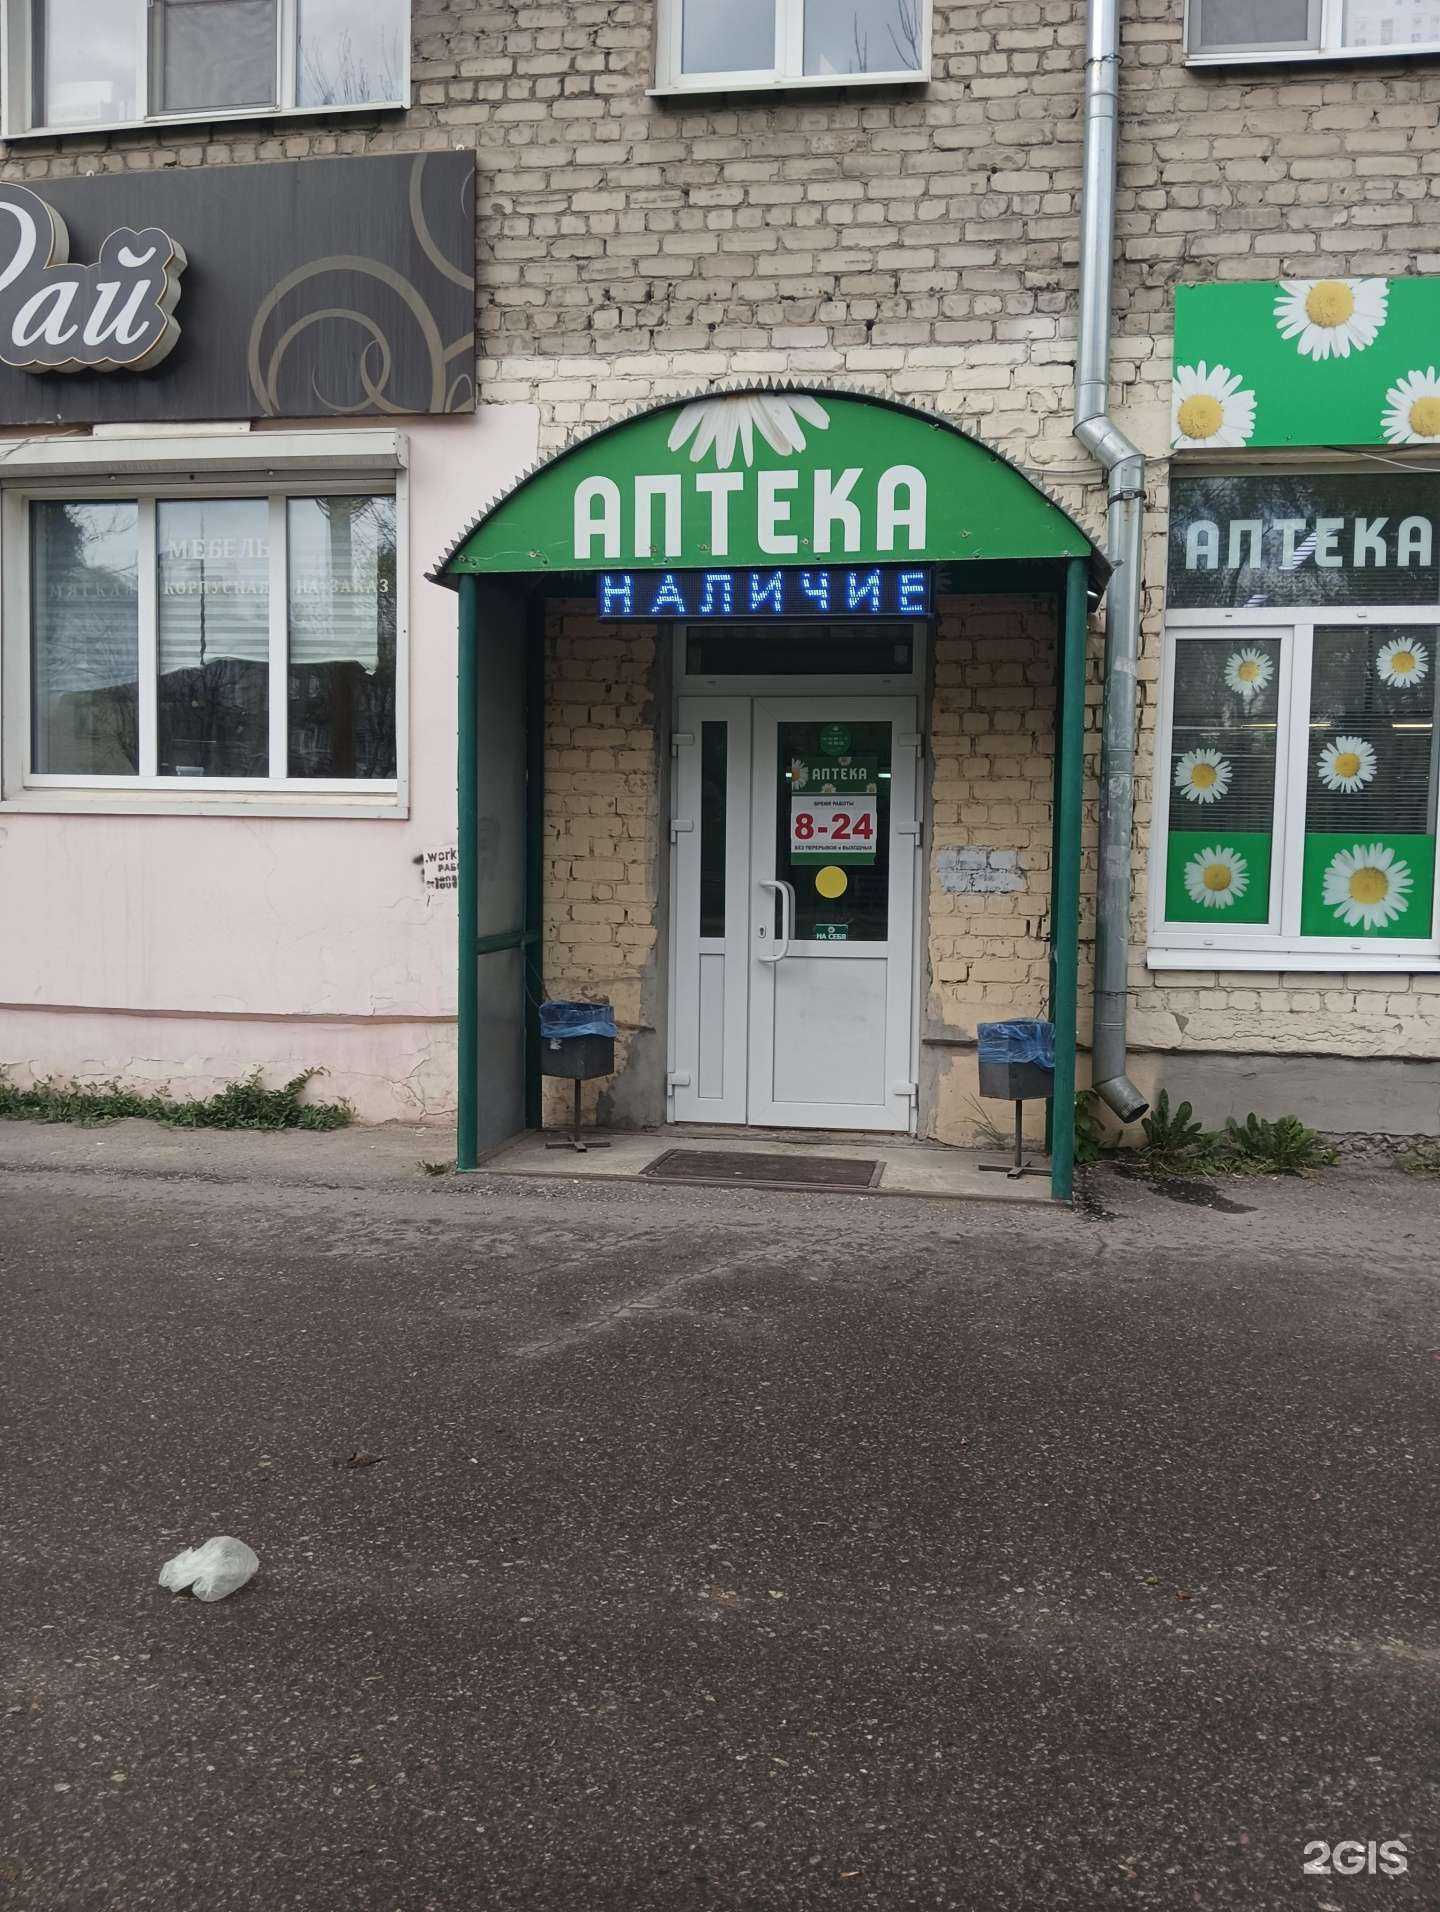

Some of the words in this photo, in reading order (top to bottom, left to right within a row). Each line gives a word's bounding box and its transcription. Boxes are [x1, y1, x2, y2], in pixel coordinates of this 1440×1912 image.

[574, 464, 927, 560] АПТЕКА
[1185, 515, 1433, 570] АПТЕКА
[603, 569, 924, 613] НАЛИЧИЕ
[812, 767, 868, 780] АПТЕКА
[794, 812, 874, 840] 8-24
